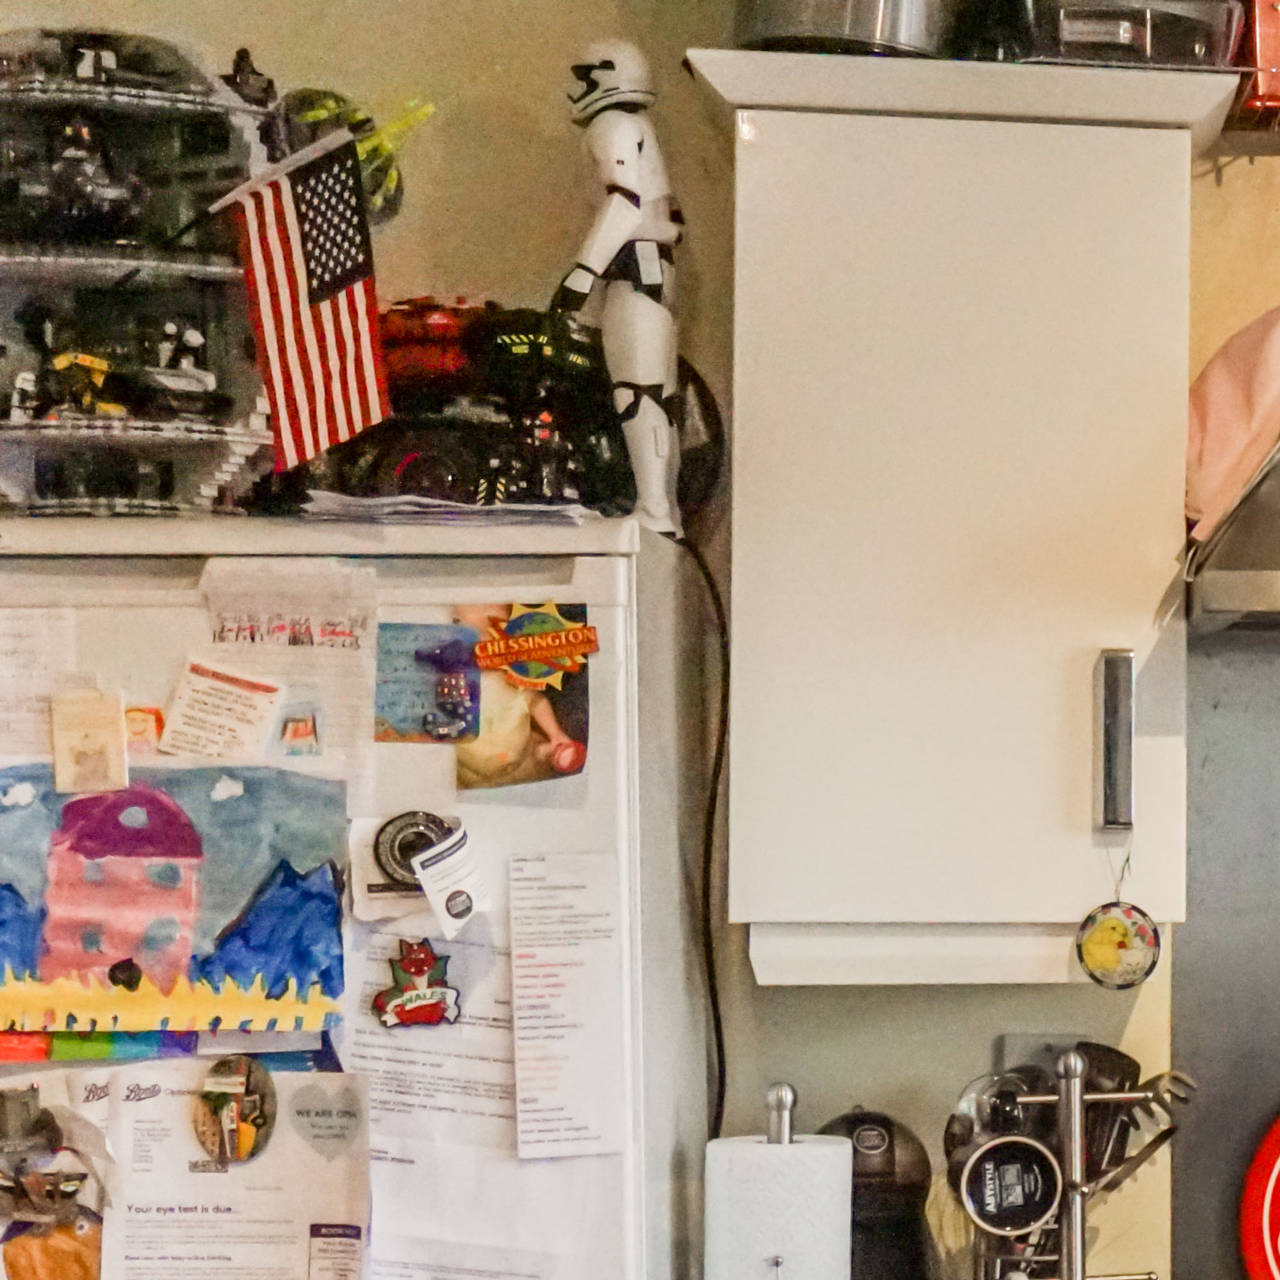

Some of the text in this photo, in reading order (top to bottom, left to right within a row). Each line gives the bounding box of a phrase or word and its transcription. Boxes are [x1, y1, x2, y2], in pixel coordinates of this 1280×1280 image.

[475, 629, 596, 657] CHESSINGTON
[401, 991, 448, 1006] WALES
[127, 1205, 152, 1214] Your
[156, 1206, 175, 1216] eye
[178, 1205, 198, 1214] test
